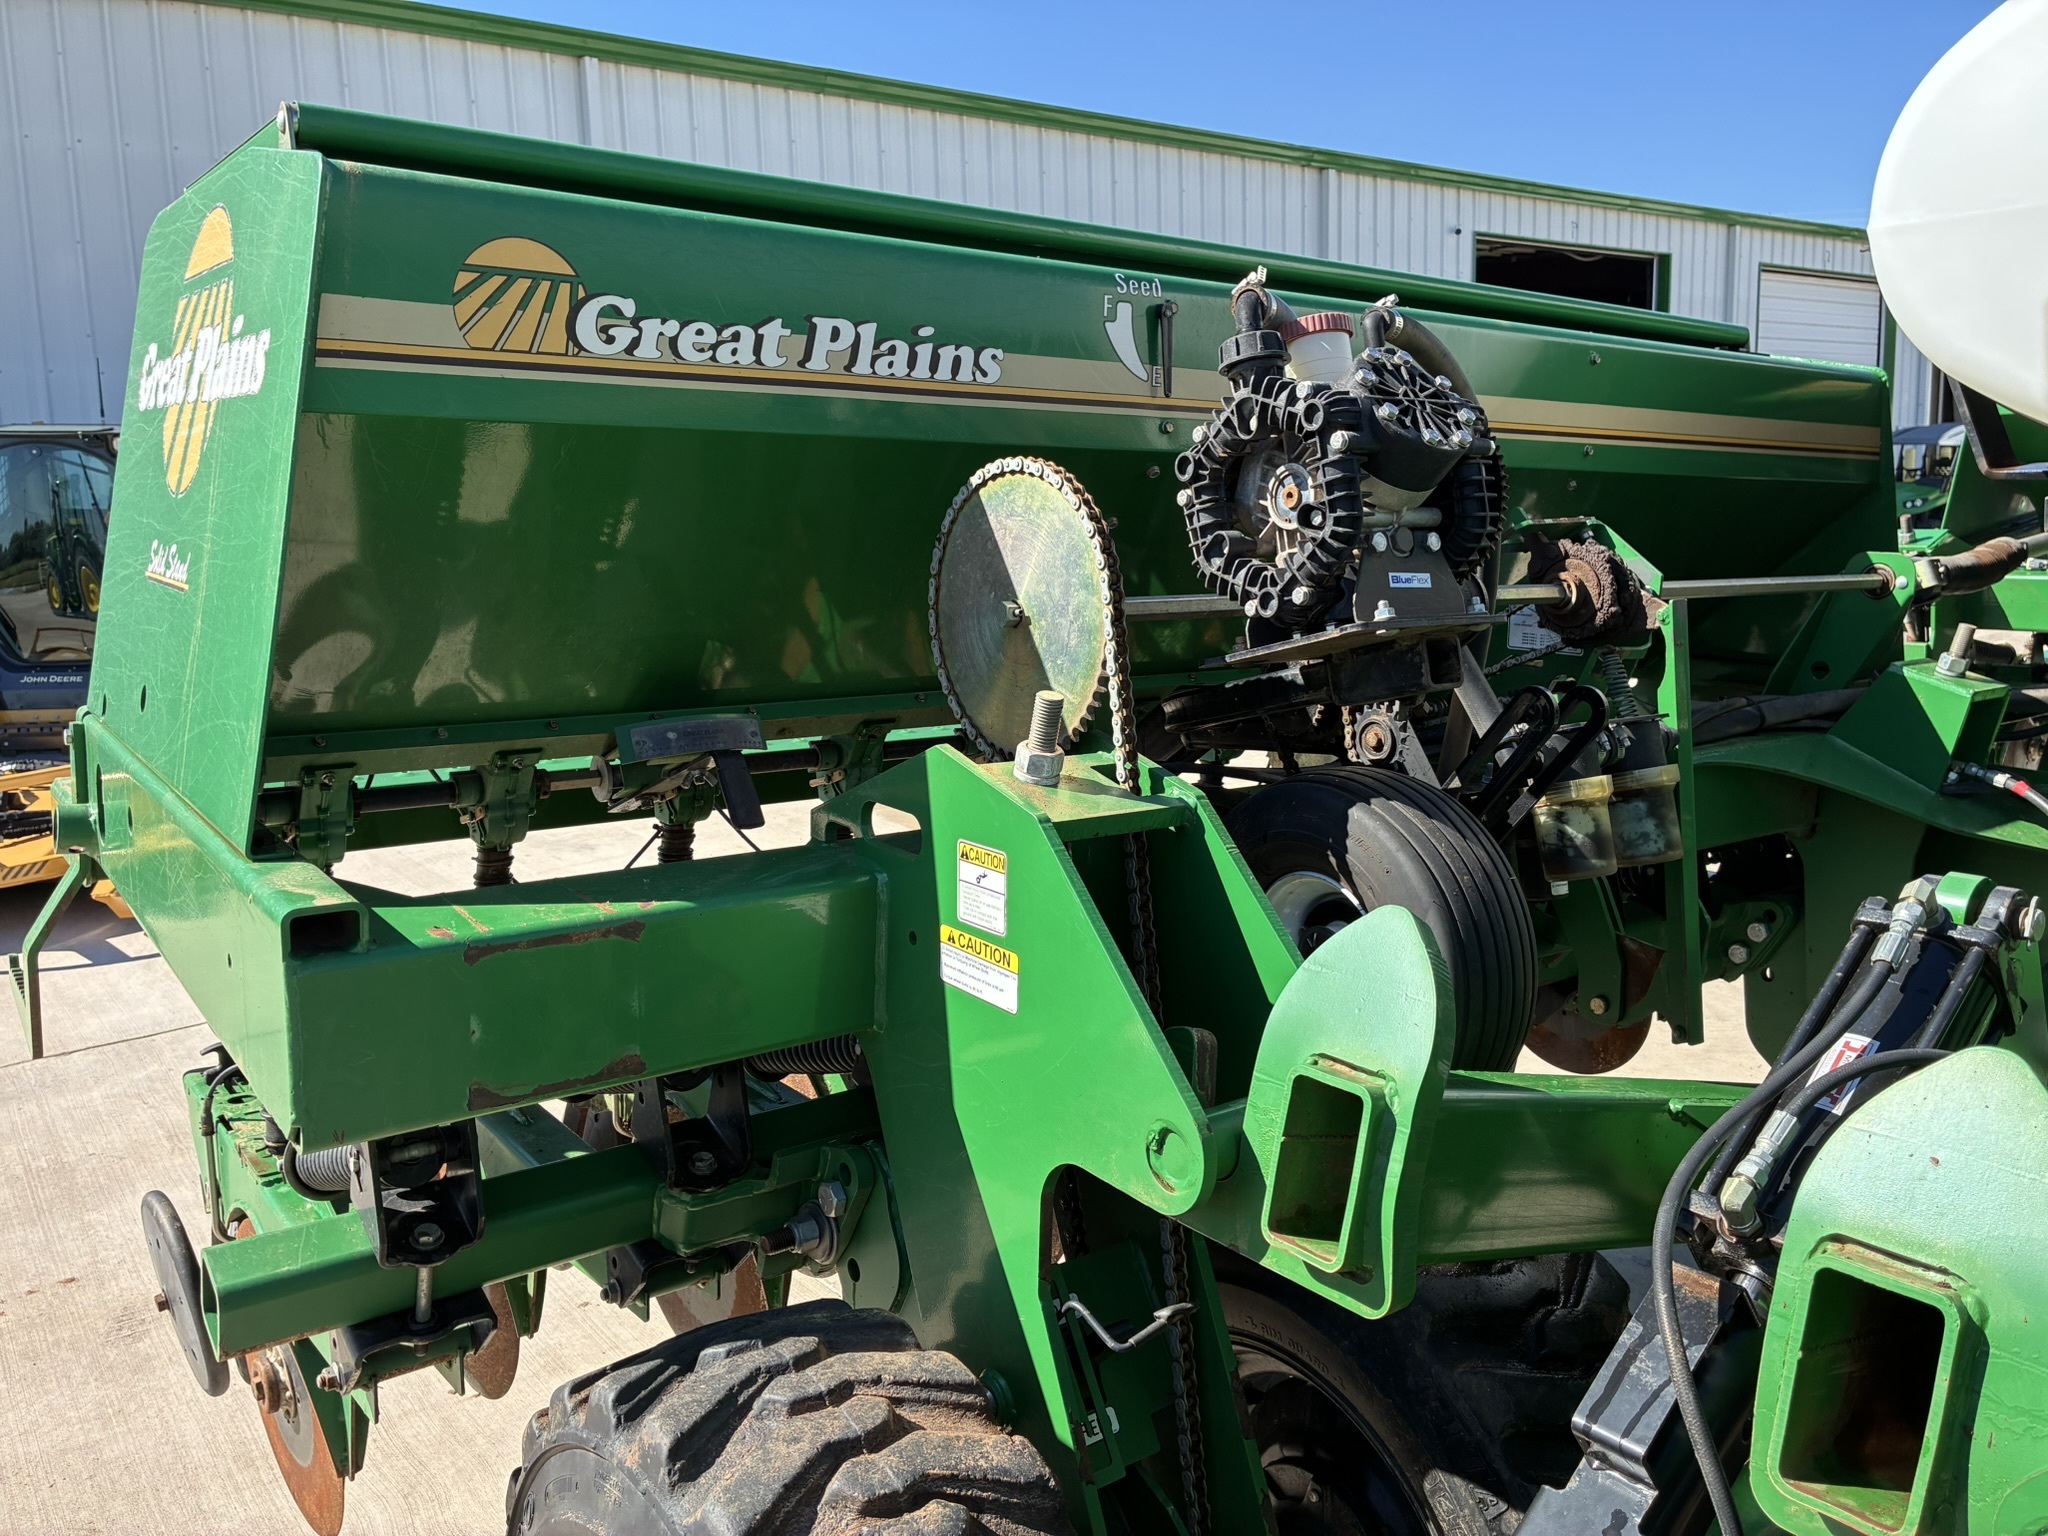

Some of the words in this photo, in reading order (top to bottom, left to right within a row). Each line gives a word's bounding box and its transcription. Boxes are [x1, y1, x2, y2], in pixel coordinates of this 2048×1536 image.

[1115, 273, 1162, 297] Seed
[1103, 294, 1113, 317] F
[570, 294, 791, 367] Great
[800, 314, 1004, 384] Plains
[139, 338, 194, 411] Great
[187, 314, 271, 404] Plains
[1152, 366, 1162, 387] E
[1391, 575, 1430, 584] BlueFlex
[20, 675, 48, 683] JOHN
[49, 675, 83, 683] DEERE
[968, 847, 1005, 870] CAUTION
[958, 933, 1011, 968] CAUTION
